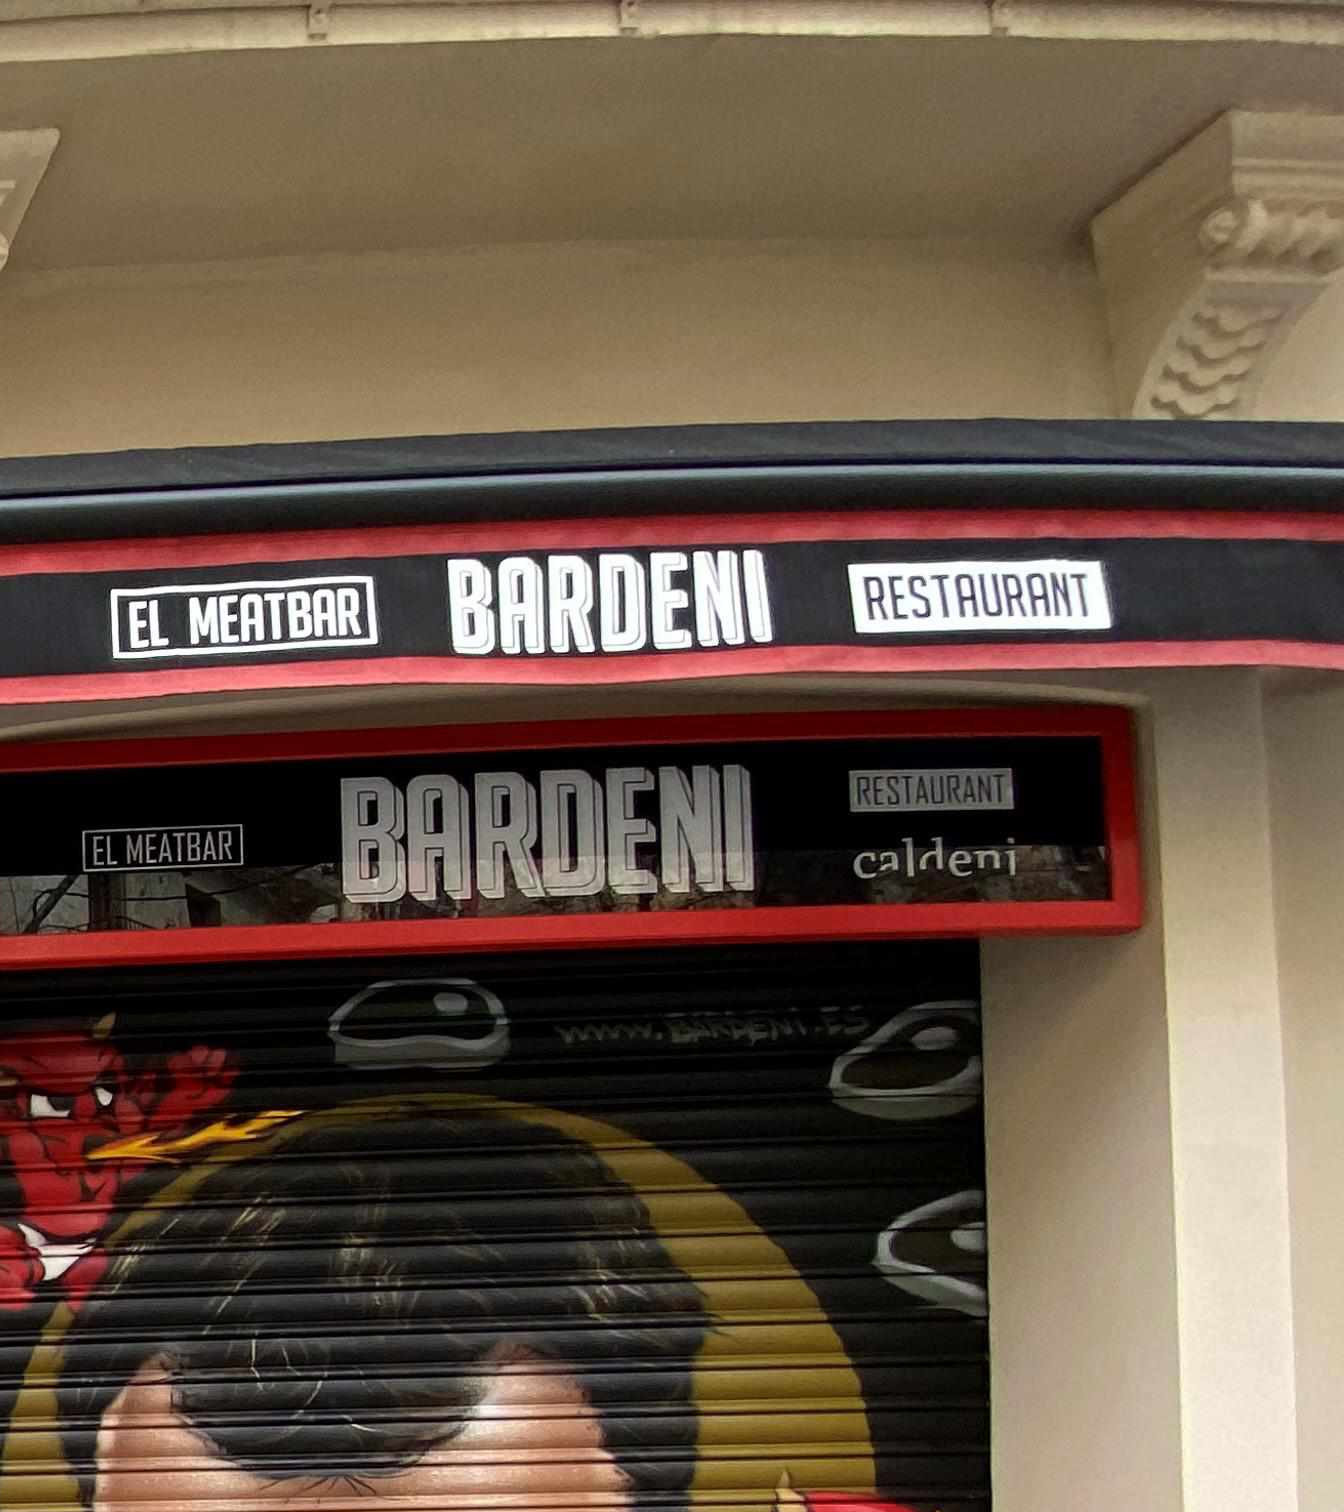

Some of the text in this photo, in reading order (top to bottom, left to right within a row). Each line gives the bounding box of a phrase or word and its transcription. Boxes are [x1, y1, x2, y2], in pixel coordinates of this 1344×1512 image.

[128, 588, 362, 649] EL MEATBAR
[446, 548, 774, 655] BARDENI
[863, 573, 1090, 620] RESTAURANT
[855, 773, 1006, 806] RESTAURANT
[92, 830, 233, 866] EL MEATBAR
[340, 765, 755, 903] BARDENI
[853, 837, 1016, 879] caldeni
